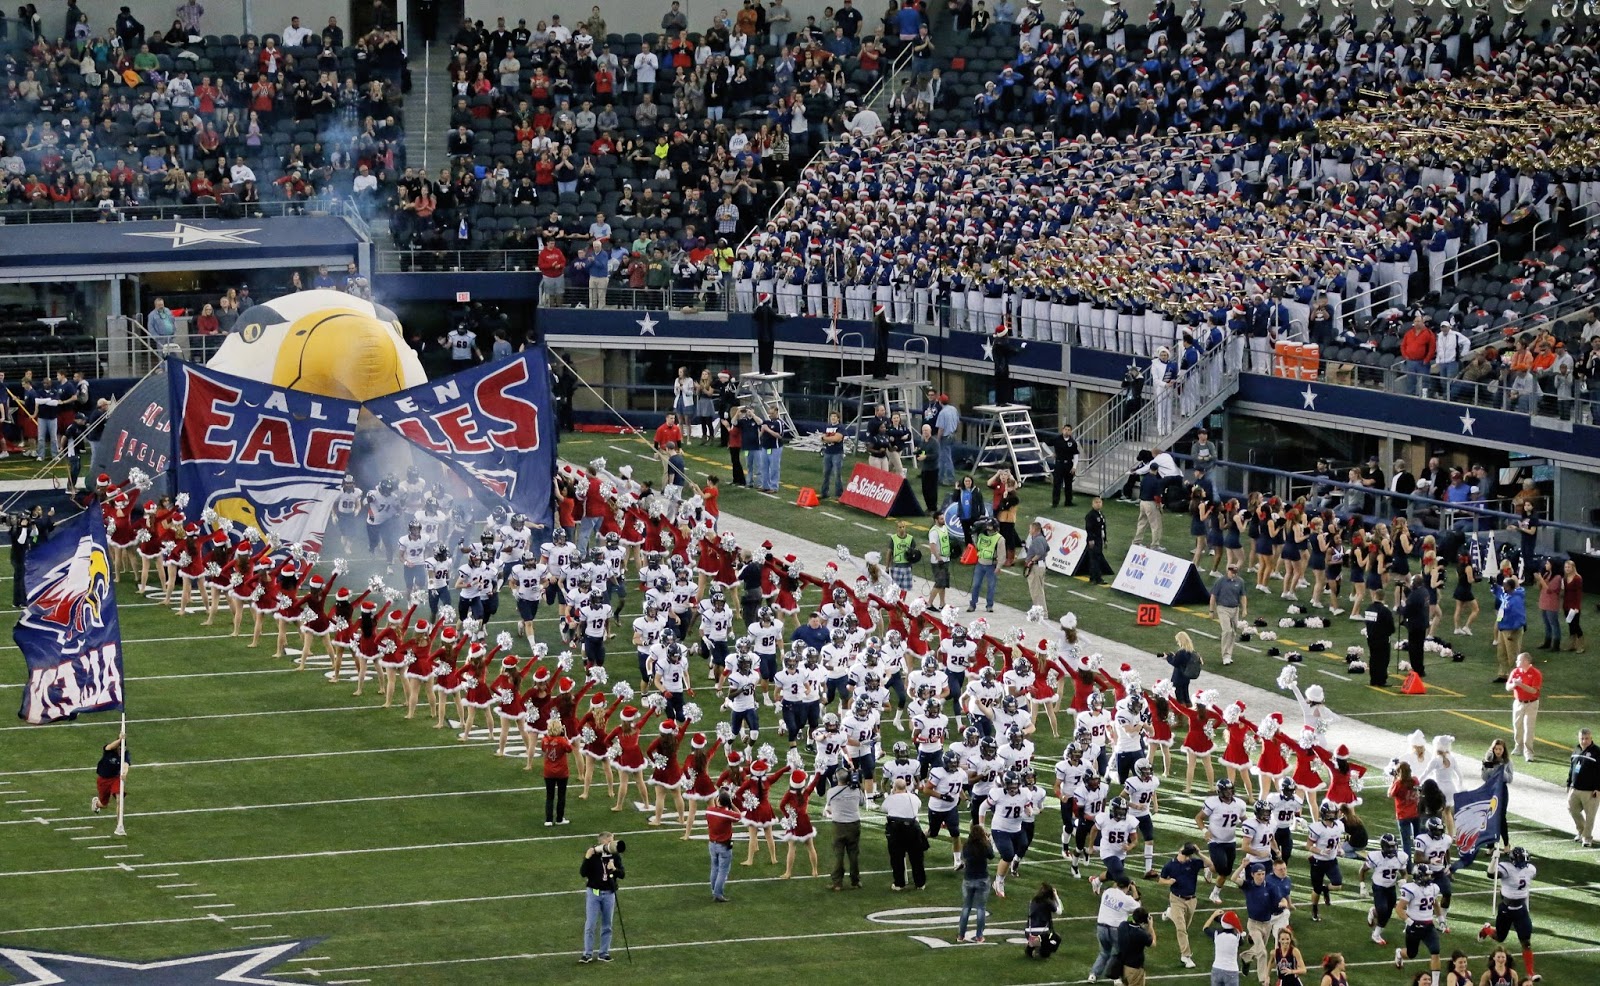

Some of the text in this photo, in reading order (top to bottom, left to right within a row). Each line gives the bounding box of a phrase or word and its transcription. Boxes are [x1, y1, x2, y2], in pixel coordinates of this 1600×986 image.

[112, 429, 169, 473] EAGLE
[558, 555, 568, 566] 61
[674, 595, 688, 604] 47
[1140, 607, 1156, 622] 20
[592, 619, 602, 629] 13
[762, 636, 774, 646] 82
[672, 672, 680, 682] 3
[792, 684, 798, 694] 3
[948, 783, 962, 795] 77
[1004, 806, 1021, 818] 78
[1222, 814, 1238, 828] 72
[1108, 832, 1125, 844] 65
[1382, 870, 1397, 880] 25
[1518, 881, 1526, 890] 2
[1420, 898, 1434, 910] 23
